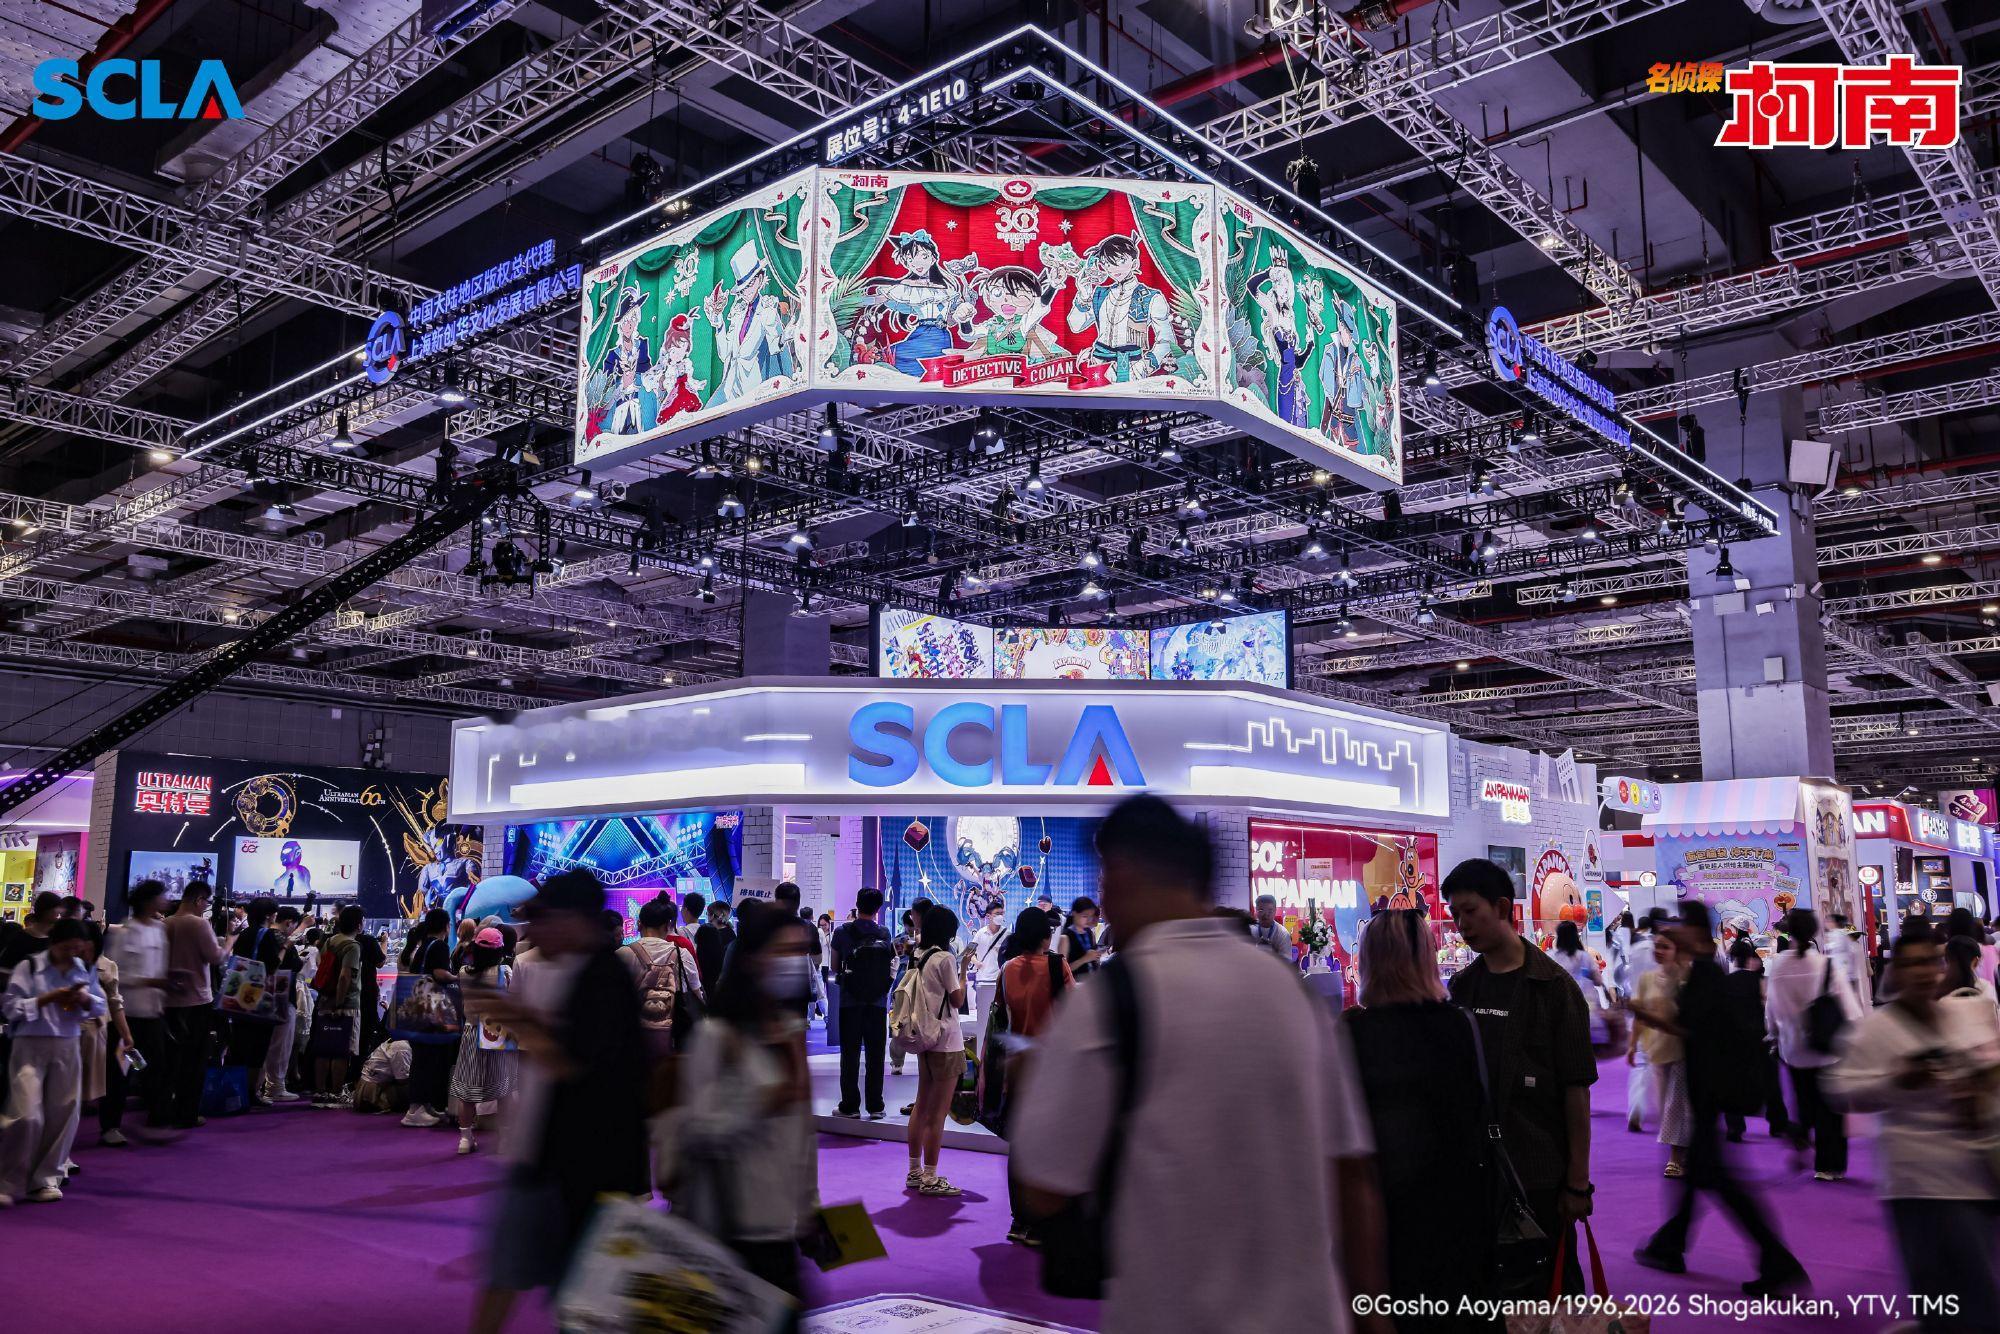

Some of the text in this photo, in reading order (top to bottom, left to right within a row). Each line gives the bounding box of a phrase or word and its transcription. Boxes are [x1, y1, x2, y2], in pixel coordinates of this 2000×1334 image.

[898, 78, 966, 125] 4-1E10
[851, 174, 889, 188] 柯南
[408, 238, 556, 329] 中国大陆地区版权总代理
[407, 262, 583, 362] 上海新创华文化发展有限公司
[362, 328, 405, 367] SCLA
[1488, 321, 1523, 367] SCLA
[952, 360, 1074, 383] DETECTIVE CONAN
[849, 701, 1147, 787] SCLA
[137, 771, 213, 791] ULTRAMAN
[323, 788, 359, 798] ULTRAMAN
[1483, 781, 1530, 803] ANPANMAN
[134, 790, 212, 816] 奥特曼
